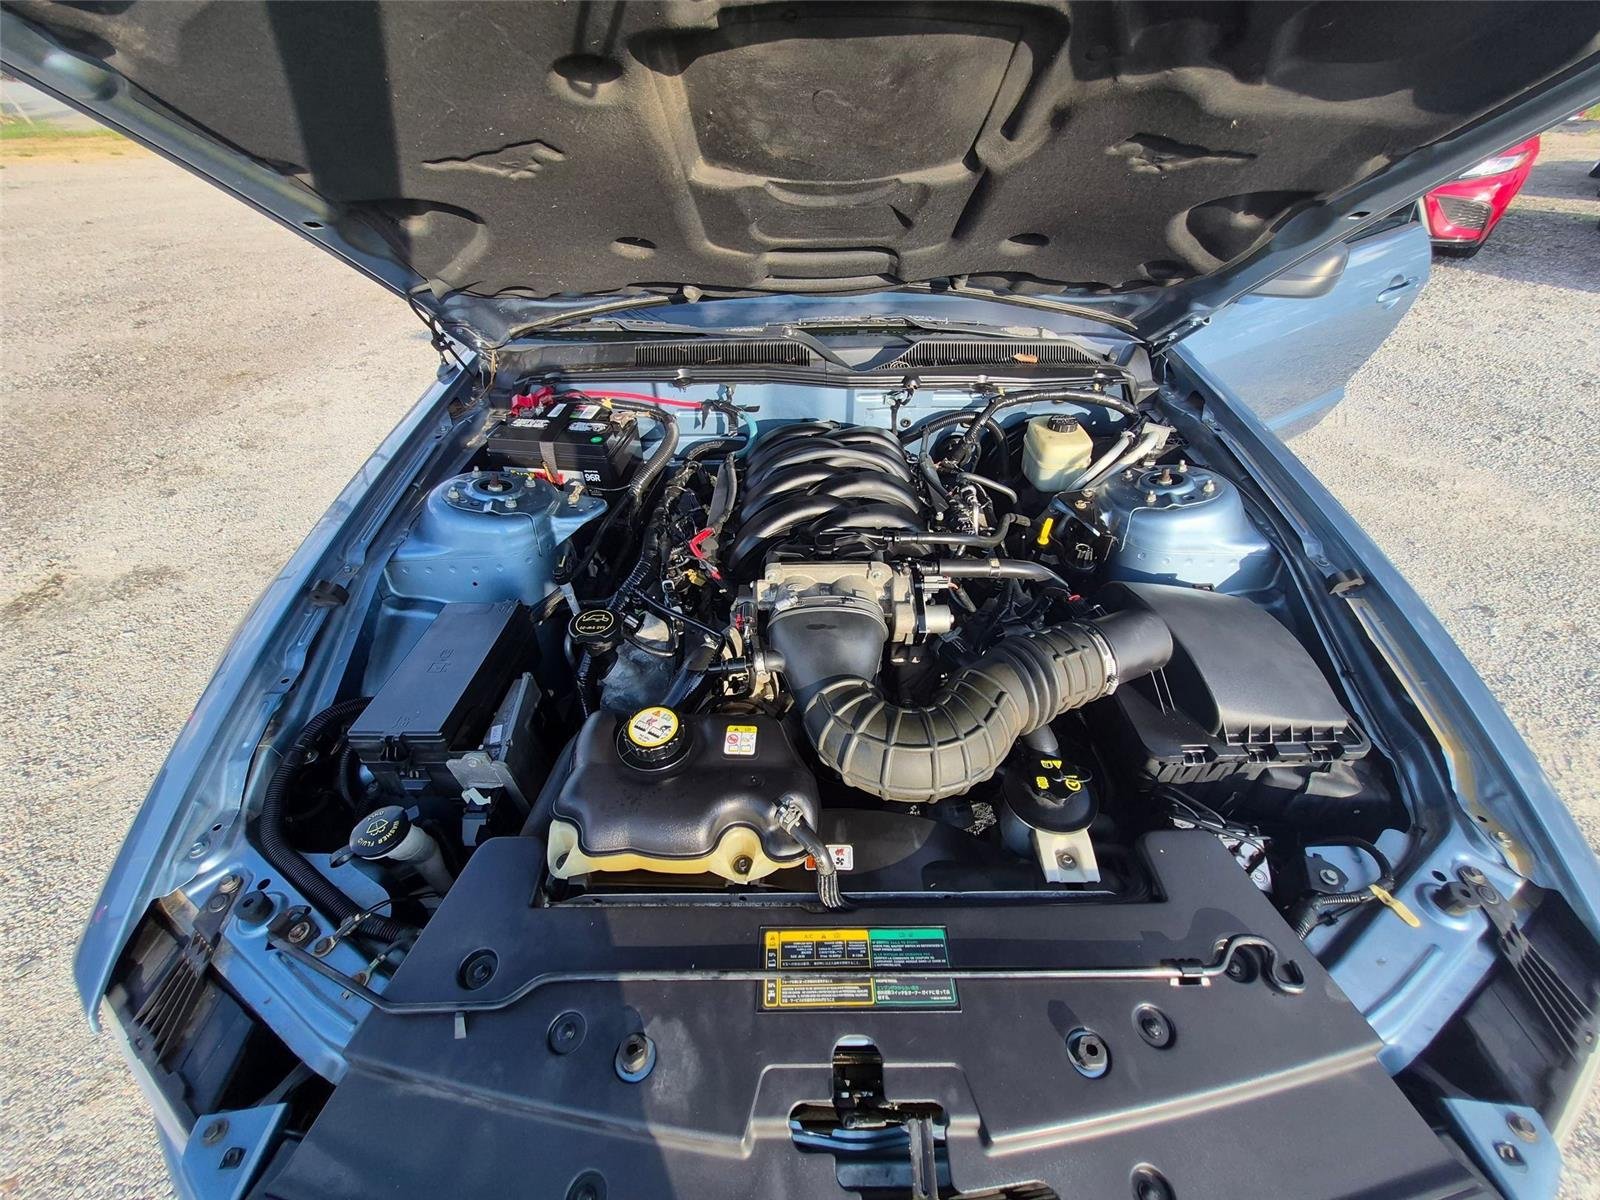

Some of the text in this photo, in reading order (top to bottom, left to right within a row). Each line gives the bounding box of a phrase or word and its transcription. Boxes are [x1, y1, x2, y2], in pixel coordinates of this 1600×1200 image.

[584, 473, 601, 482] 96R
[357, 820, 400, 847] WASHER FLUID
